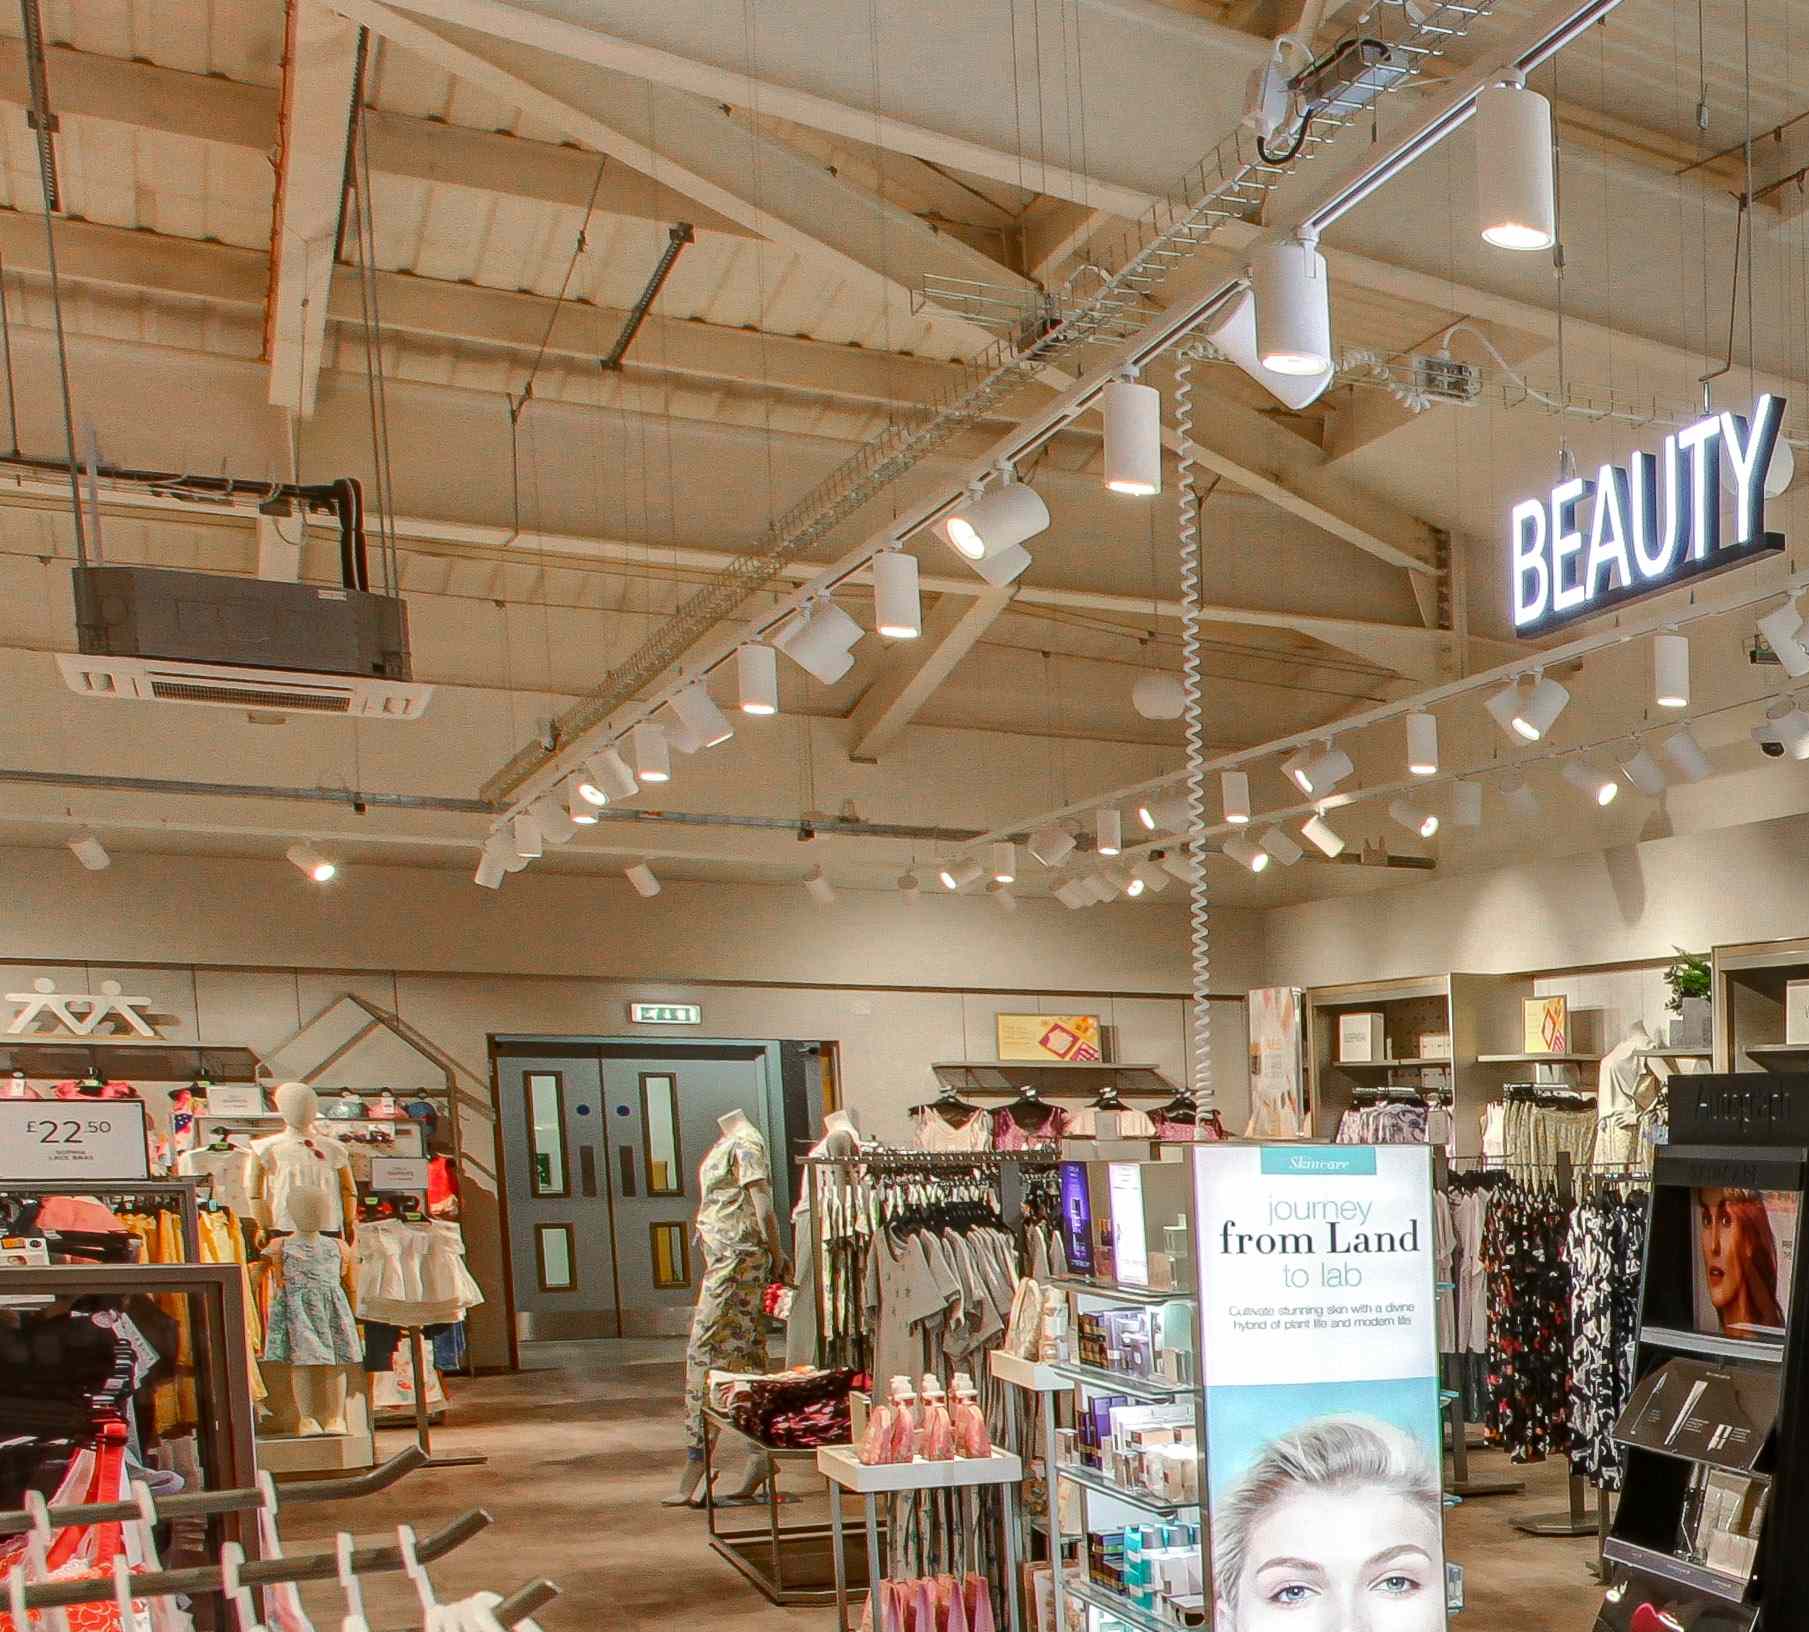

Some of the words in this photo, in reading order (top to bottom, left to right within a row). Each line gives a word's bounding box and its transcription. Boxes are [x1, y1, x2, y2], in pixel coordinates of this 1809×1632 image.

[1512, 393, 1783, 627] BEAUTY
[1287, 1155, 1350, 1170] Skincare
[1266, 1194, 1373, 1226] journey
[1219, 1219, 1316, 1255] from
[1325, 1218, 1421, 1254] Land
[1283, 1263, 1310, 1288] to
[1321, 1260, 1363, 1288] lab
[1278, 1303, 1324, 1318] stunning
[1327, 1302, 1349, 1314] skin
[1351, 1301, 1373, 1313] with
[1384, 1301, 1415, 1313] divine
[1233, 1319, 1267, 1332] hybrid
[1271, 1319, 1282, 1329] of
[1285, 1318, 1311, 1331] plant
[1330, 1317, 1351, 1328] and
[1354, 1316, 1395, 1327] modern
